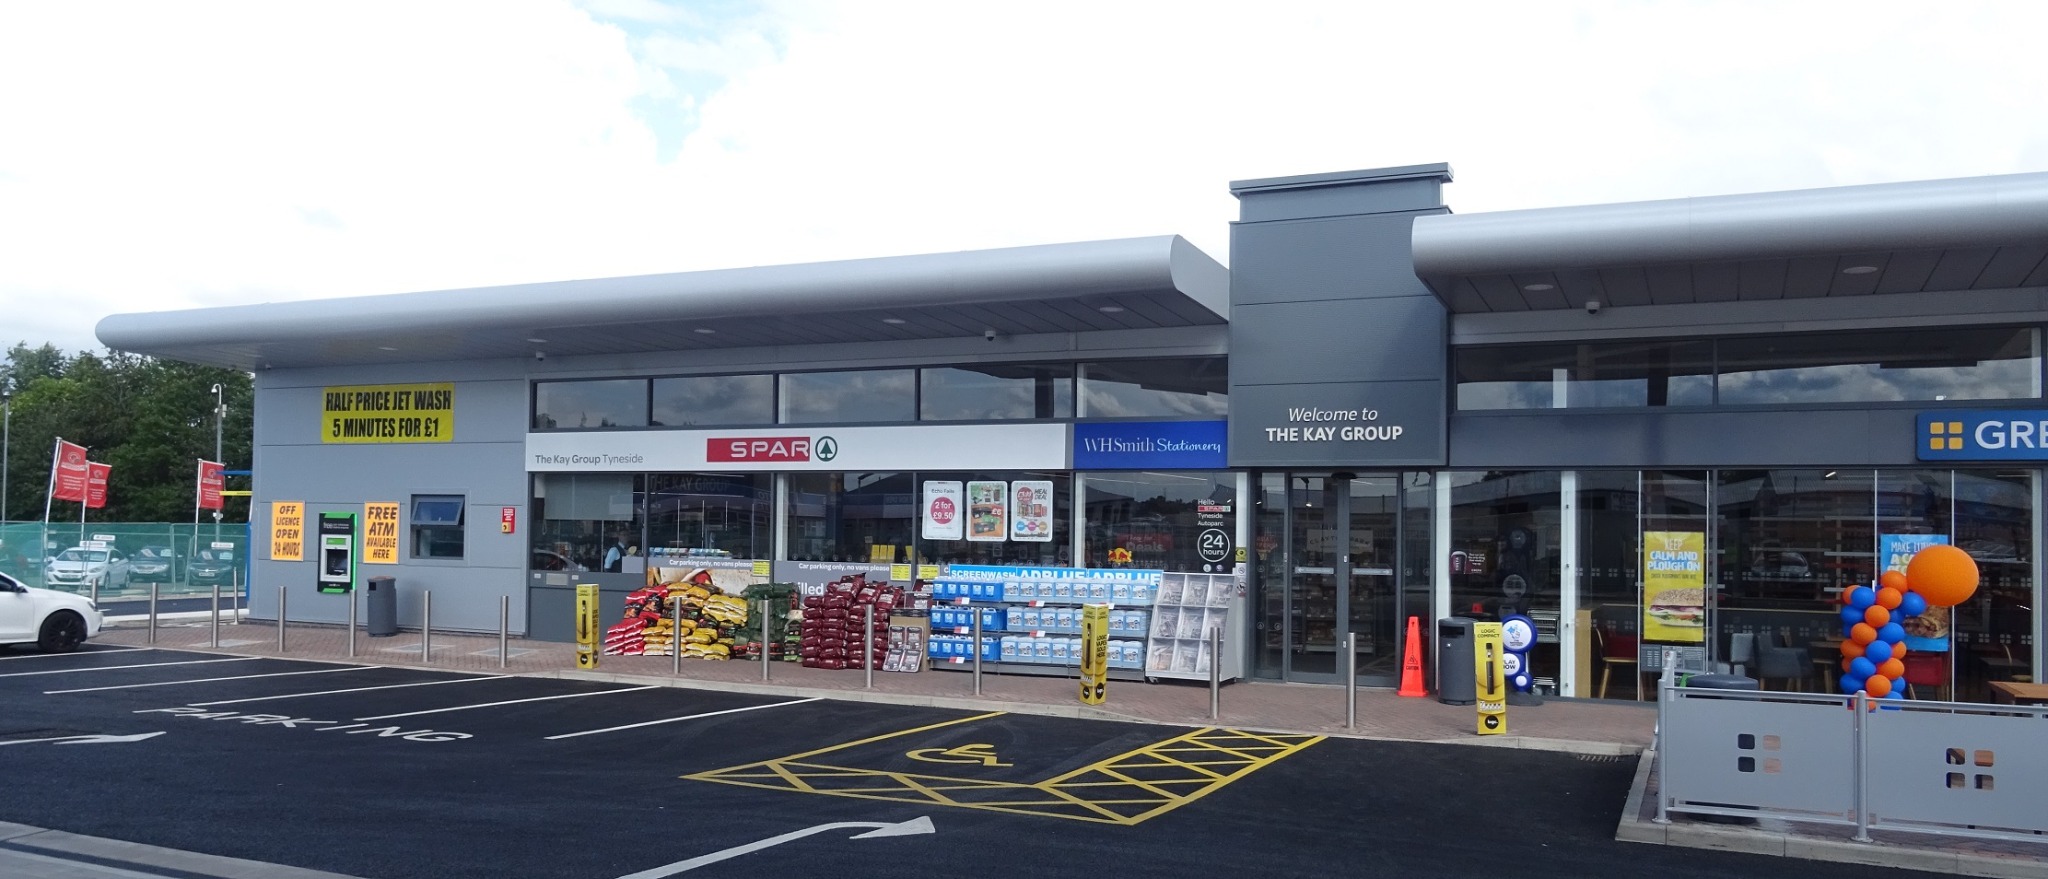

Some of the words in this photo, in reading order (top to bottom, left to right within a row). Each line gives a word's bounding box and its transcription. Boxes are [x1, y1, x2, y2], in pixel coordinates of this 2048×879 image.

[326, 392, 353, 411] HALF
[356, 391, 390, 411] PRICE
[392, 391, 411, 410] JET
[414, 390, 451, 410] WASH
[1289, 408, 1358, 422] Welcome
[1362, 408, 1378, 420] to
[333, 418, 340, 437] 5
[344, 418, 396, 437] MINUTES
[399, 418, 421, 437] FOR
[424, 417, 438, 437] £1
[1266, 428, 1298, 442] THE
[1303, 427, 1336, 441] KAY
[1340, 426, 1403, 441] GROUP
[730, 440, 808, 458] SPAR
[1084, 437, 1154, 452] WHSmith
[1156, 438, 1220, 454] Stationery
[535, 454, 552, 464] The
[554, 454, 570, 466] Kay
[572, 454, 600, 466] Group
[602, 454, 644, 466] Tyneside
[672, 476, 694, 492] KAY
[280, 506, 296, 514] OFF
[941, 501, 952, 509] for
[368, 506, 398, 520] FREE
[276, 517, 300, 526] LICENCE
[276, 529, 299, 539] OPEN
[369, 522, 394, 536] ATM
[366, 538, 396, 548] AVAILABLE
[1203, 534, 1224, 548] 24
[1664, 538, 1683, 550] KEEP
[1891, 542, 1911, 552] MAKE
[274, 542, 281, 556] 24
[282, 542, 300, 556] HOURS
[372, 550, 390, 559] HERE
[1650, 550, 1674, 560] CALM
[1678, 551, 1698, 560] AND
[1647, 560, 1684, 570] PLOUGH
[1686, 561, 1700, 571] ON
[951, 570, 1016, 580] SCREENWASH
[132, 706, 473, 742] PARKING
